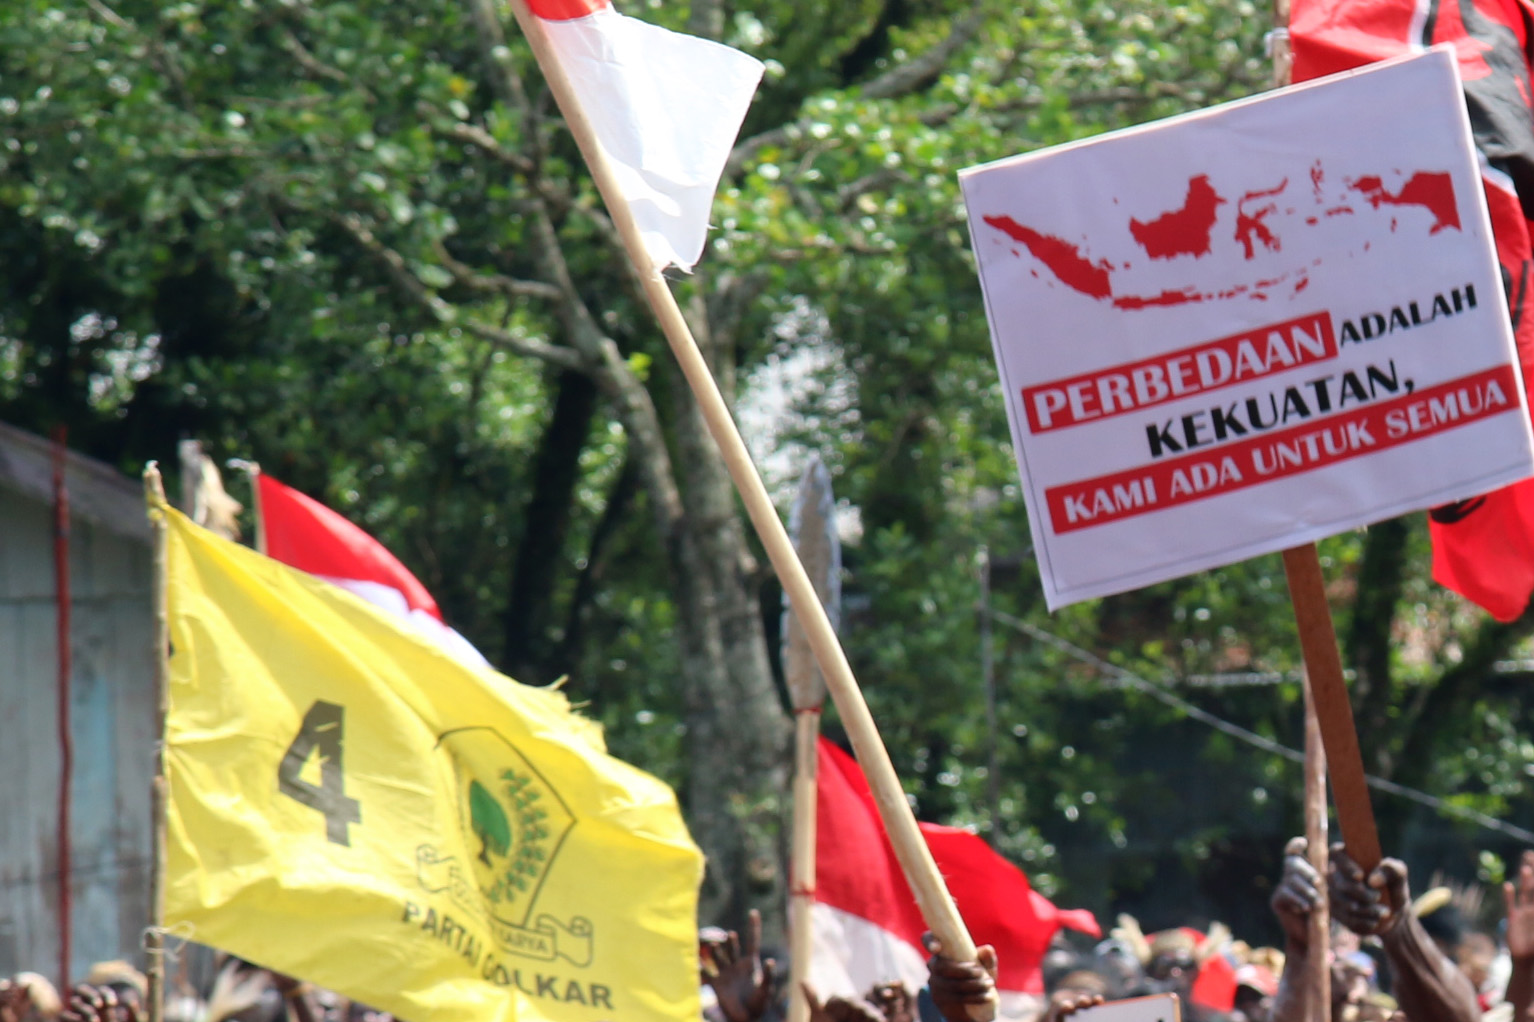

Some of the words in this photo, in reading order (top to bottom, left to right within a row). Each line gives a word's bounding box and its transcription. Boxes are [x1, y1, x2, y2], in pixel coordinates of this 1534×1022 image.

[1032, 320, 1327, 429] PERBEDAAN
[1339, 284, 1478, 347] ADALAH
[1146, 360, 1415, 458] KEKUATAN,
[1064, 475, 1157, 524] KAMI
[1169, 459, 1242, 498] ADA
[1251, 419, 1375, 475] UNTUK
[1385, 380, 1508, 438] SEMUA
[278, 699, 361, 848] 4
[402, 901, 482, 967] PARTAI
[482, 953, 617, 1011] GOLKAR
